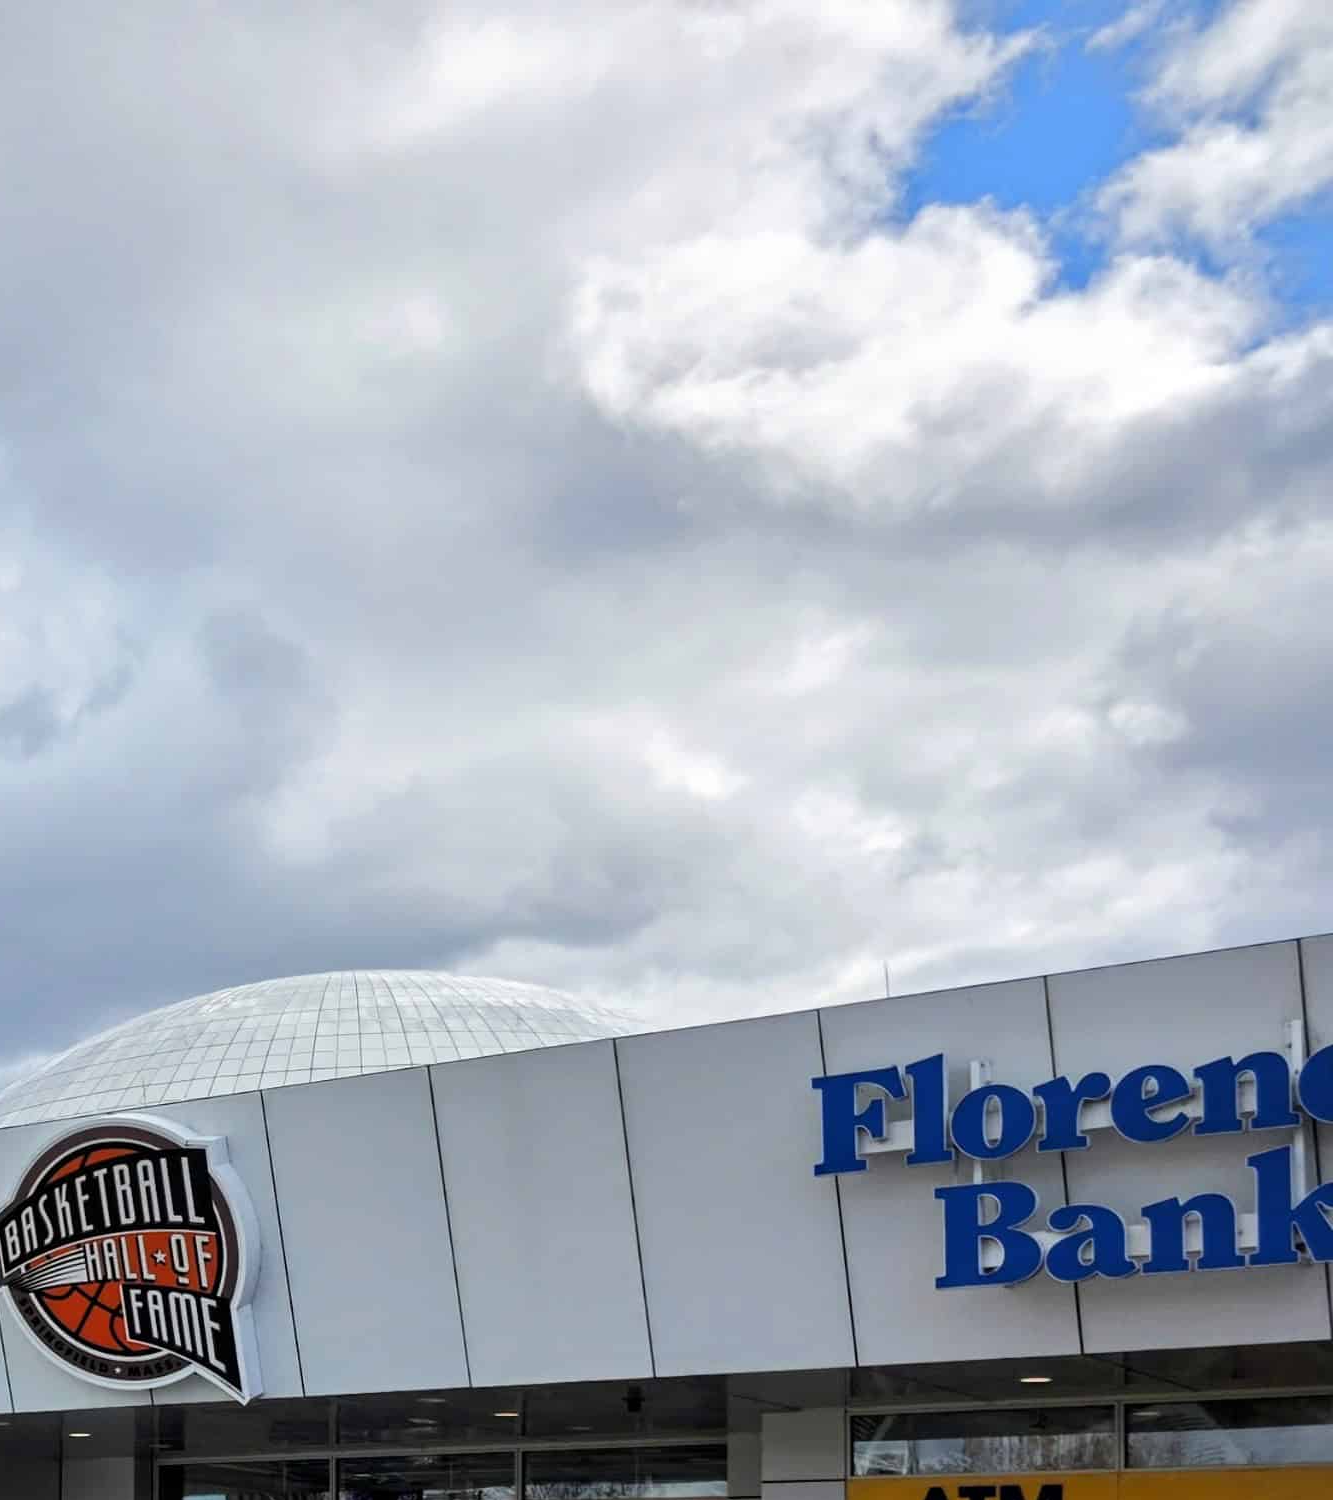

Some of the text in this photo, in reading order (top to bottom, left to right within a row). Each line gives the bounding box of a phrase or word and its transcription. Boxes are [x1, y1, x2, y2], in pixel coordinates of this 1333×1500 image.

[4, 1157, 206, 1263] BASKETBALL
[935, 1144, 1333, 1289] Bank
[85, 1234, 212, 1288] HALL OF
[19, 1296, 109, 1374] SPRINGFIELD
[129, 1289, 227, 1373] FAME
